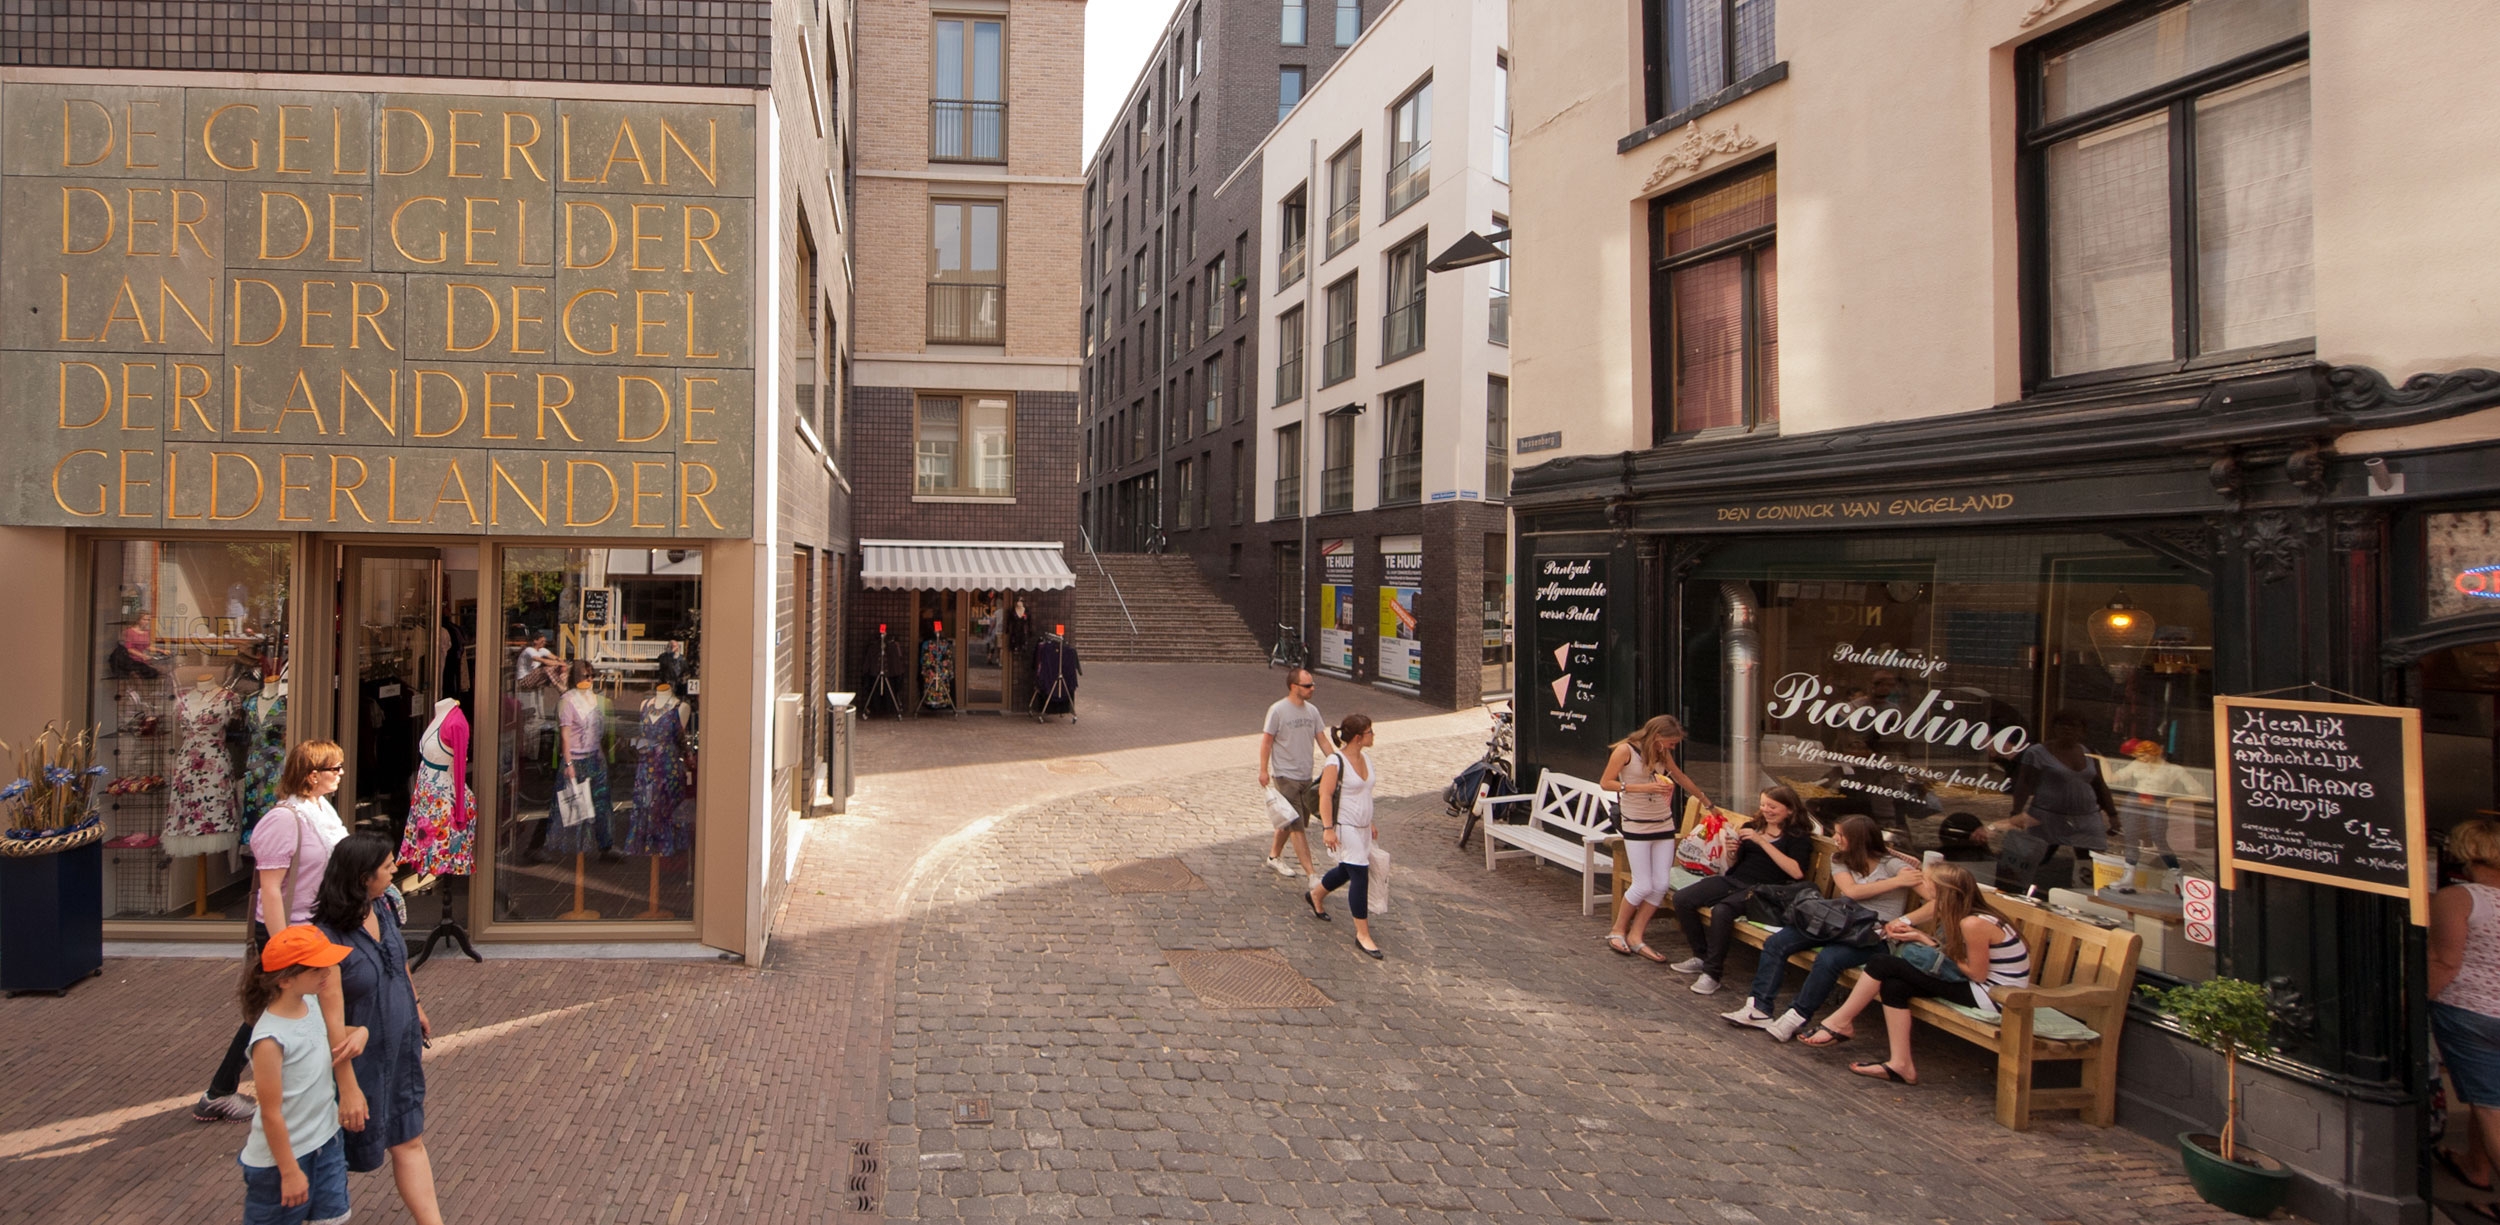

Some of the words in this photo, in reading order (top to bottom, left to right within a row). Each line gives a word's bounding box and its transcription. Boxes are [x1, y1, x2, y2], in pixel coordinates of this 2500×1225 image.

[62, 99, 160, 170] DE
[202, 103, 718, 187] GELDERLAN
[61, 185, 215, 259] DER
[257, 190, 364, 263] DE
[390, 194, 728, 275] GELDER
[60, 272, 397, 351] LANDER
[58, 361, 582, 443] DERLANDER
[616, 374, 719, 446] DE
[51, 448, 725, 531] GELDERLANDER
[1717, 507, 1750, 521] DEN
[1756, 502, 1834, 520] CONINCK
[1842, 501, 1880, 517] VAN
[1888, 493, 2014, 515] ENGELAND
[1325, 556, 1335, 569] TE
[1384, 554, 1396, 569] TE
[1535, 581, 1607, 601] zelfgemaakte
[1540, 609, 1566, 620] verse
[559, 622, 646, 660] NICE
[1833, 643, 1948, 678] Patathuisje
[1767, 672, 2031, 756] Piccolino
[1780, 741, 1895, 771] zelfgemaakte
[1897, 763, 1947, 781] verse
[1946, 769, 2012, 793] patat
[1840, 777, 1865, 791] en
